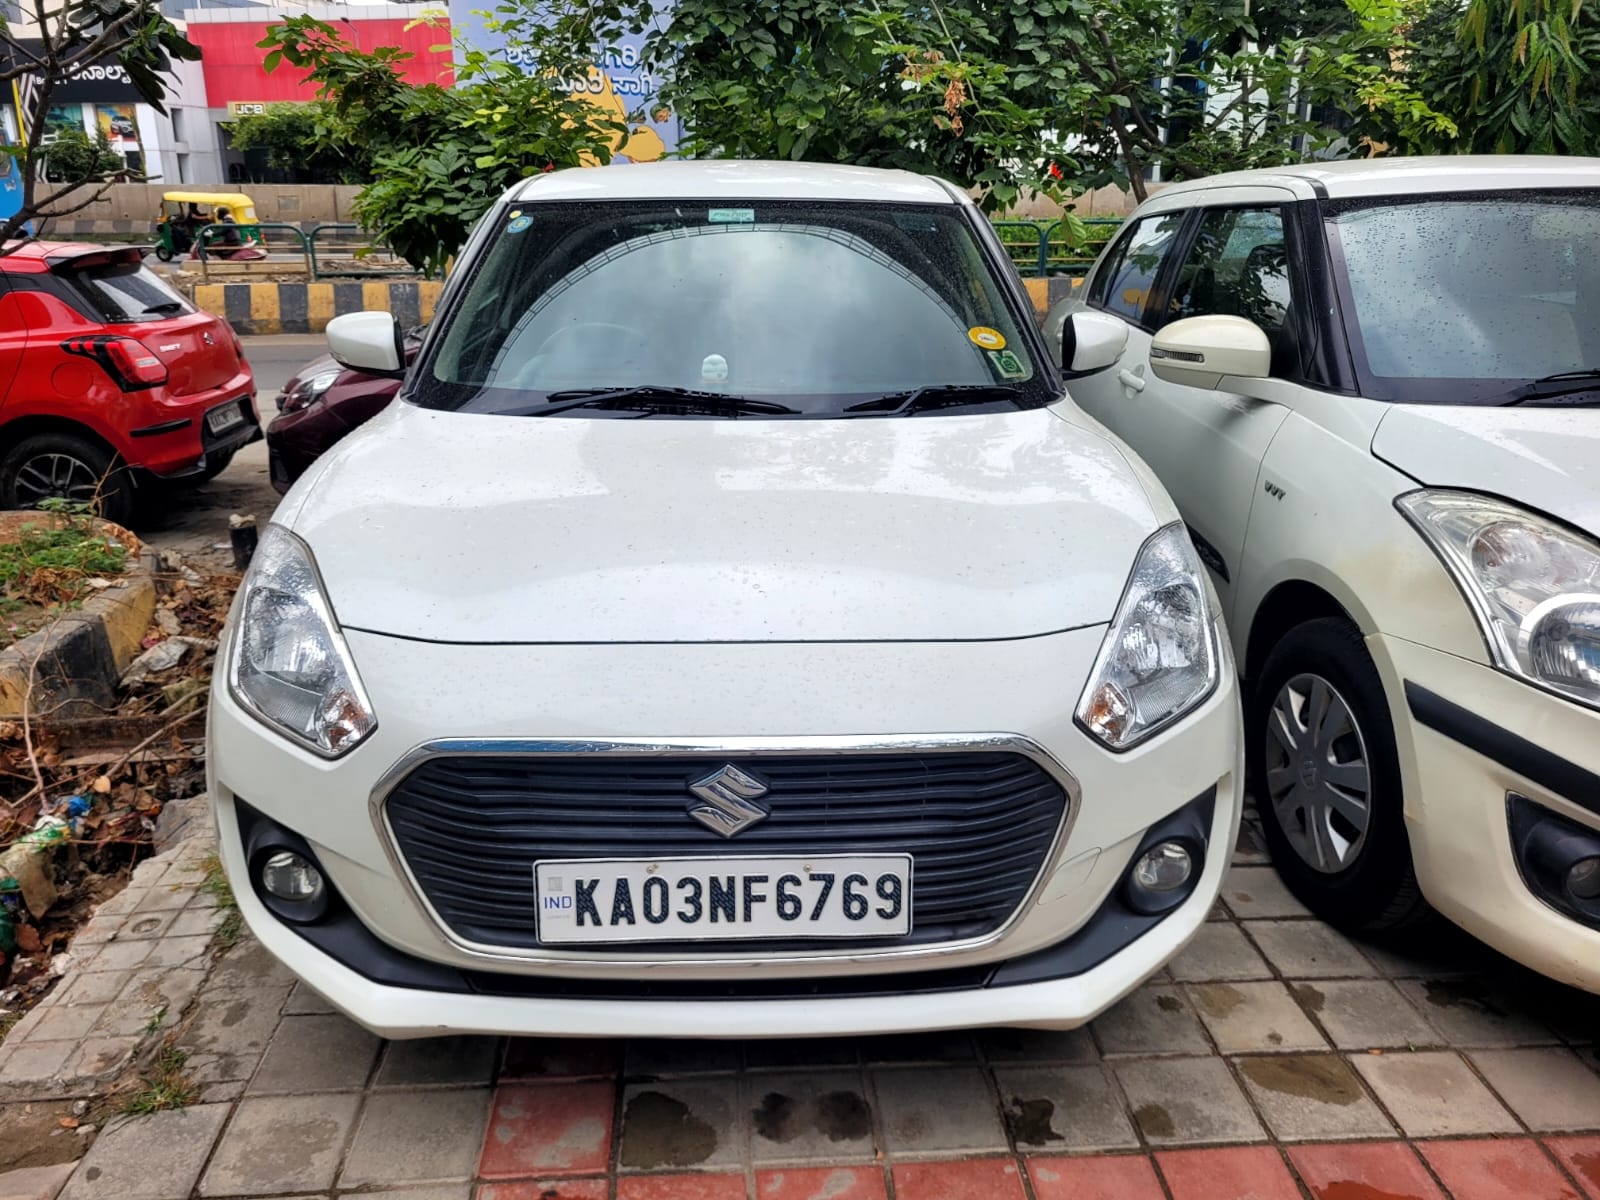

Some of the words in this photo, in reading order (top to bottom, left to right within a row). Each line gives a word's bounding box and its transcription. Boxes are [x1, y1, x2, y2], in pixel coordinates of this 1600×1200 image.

[236, 104, 264, 115] JCB
[544, 895, 572, 909] IND
[575, 873, 902, 927] KA03NF6769
